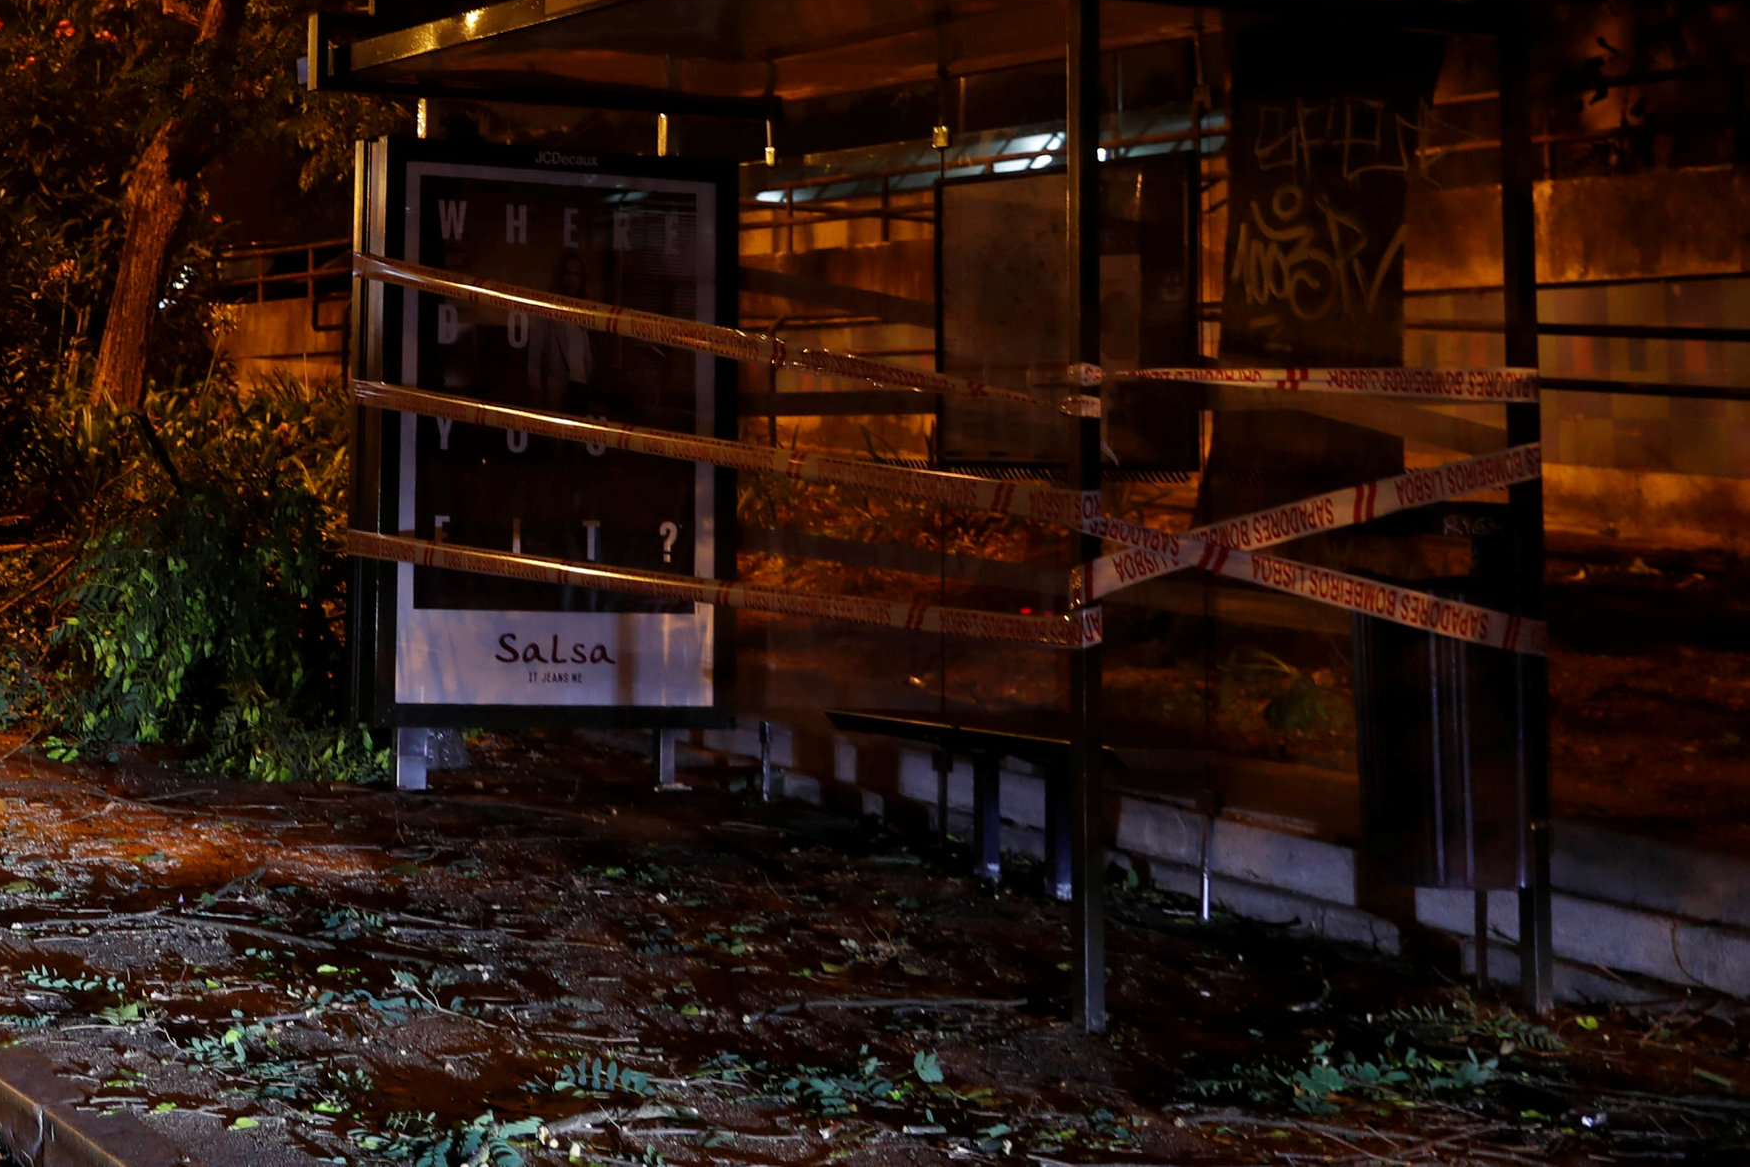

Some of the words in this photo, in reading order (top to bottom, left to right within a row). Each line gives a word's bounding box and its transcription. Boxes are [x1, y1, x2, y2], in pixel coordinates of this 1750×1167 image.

[534, 150, 599, 168] JCDecaux
[1394, 470, 1446, 505] LISBOA
[1253, 498, 1335, 544] SAPADORES
[1252, 553, 1305, 591] LISBOA
[1309, 568, 1398, 621] BOMBEIROS
[1400, 594, 1490, 640] SAPADORES
[495, 632, 617, 665] Salsa
